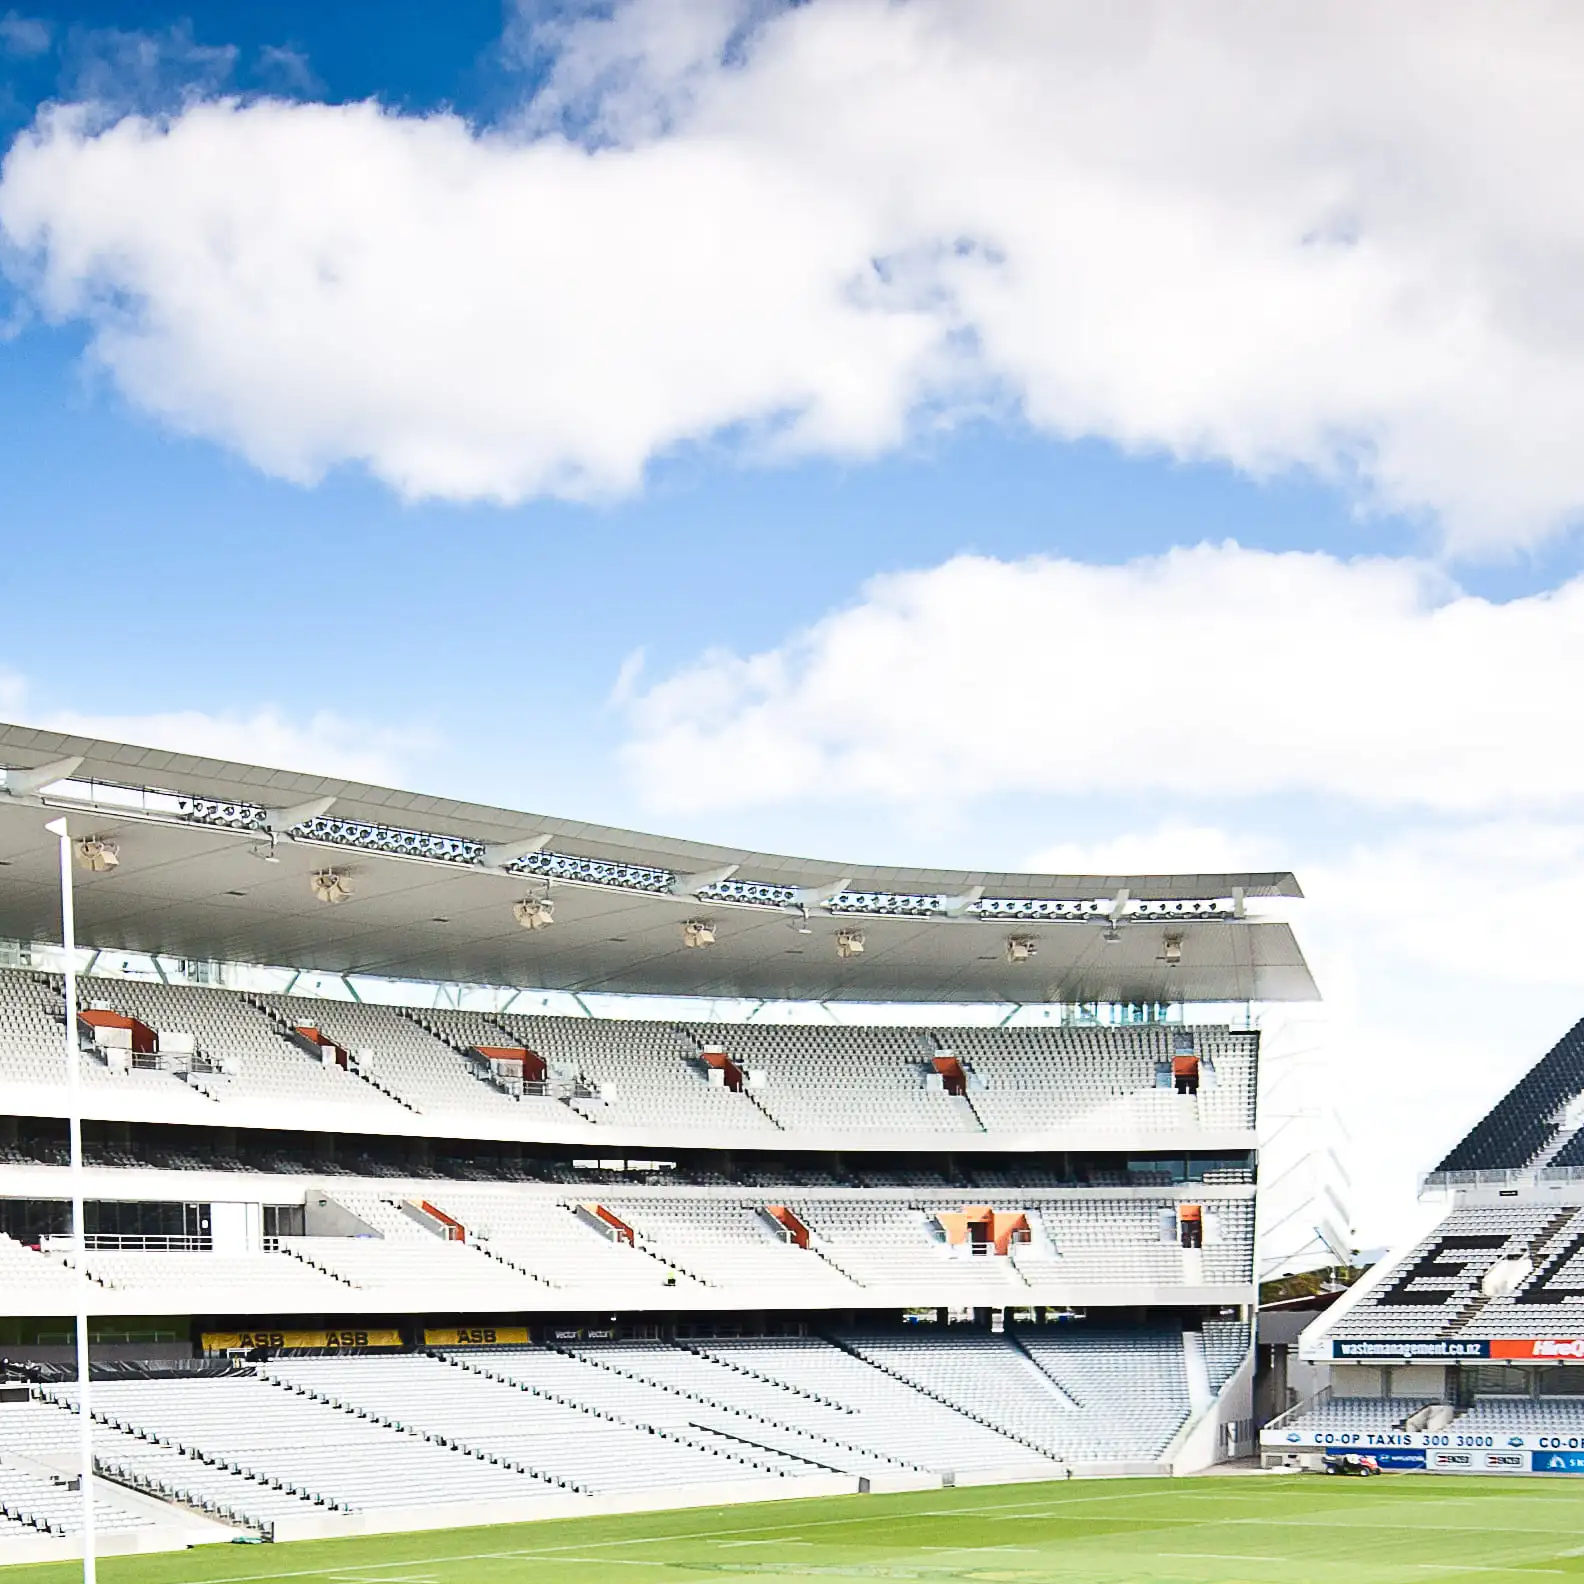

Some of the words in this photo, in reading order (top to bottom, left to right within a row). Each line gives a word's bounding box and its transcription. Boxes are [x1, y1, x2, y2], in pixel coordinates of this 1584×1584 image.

[239, 1332, 285, 1348] ASB
[326, 1331, 369, 1347] ASB
[457, 1329, 497, 1344] ASB
[1341, 1341, 1481, 1358] wastemanagement.co.nz
[1314, 1433, 1360, 1445] CO-OP
[1367, 1434, 1412, 1446] TAXIS
[1422, 1435, 1449, 1447] 300
[1457, 1436, 1493, 1447] 3000
